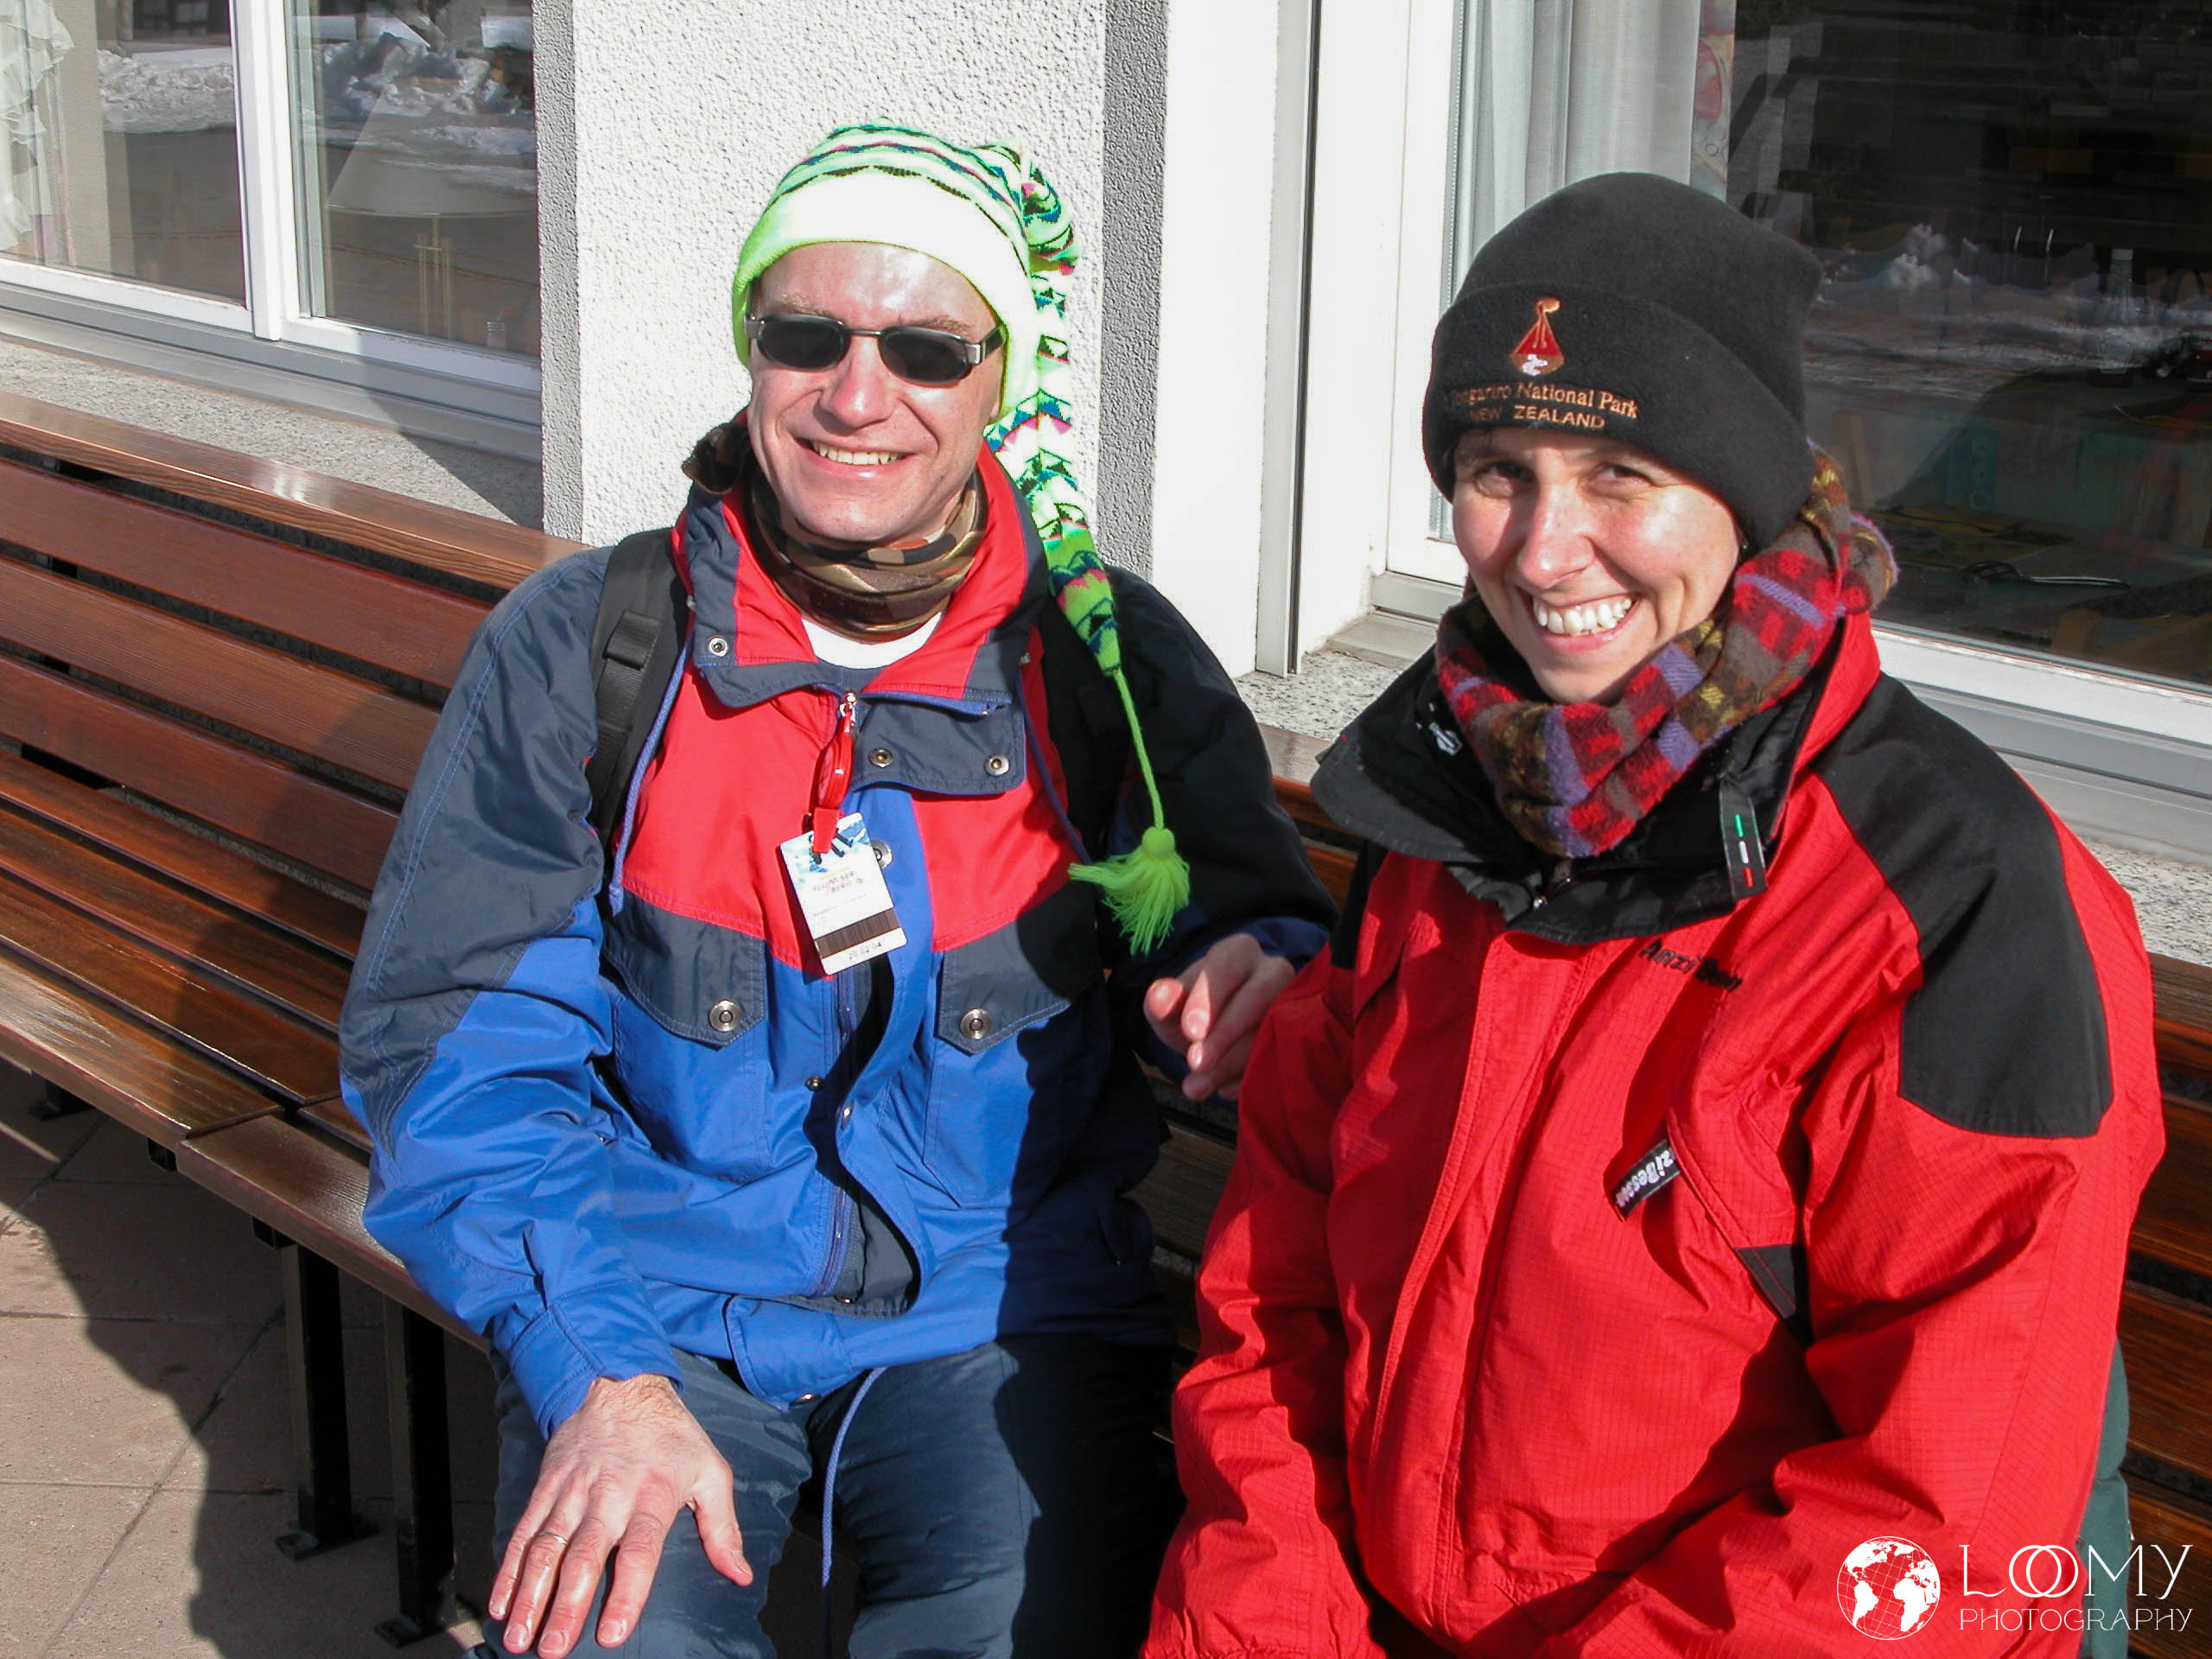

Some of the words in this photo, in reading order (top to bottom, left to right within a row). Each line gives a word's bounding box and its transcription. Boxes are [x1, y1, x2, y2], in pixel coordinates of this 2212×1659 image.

[1516, 382, 1593, 407] National
[1599, 391, 1639, 418] Park
[1514, 404, 1605, 429] ZEALAND
